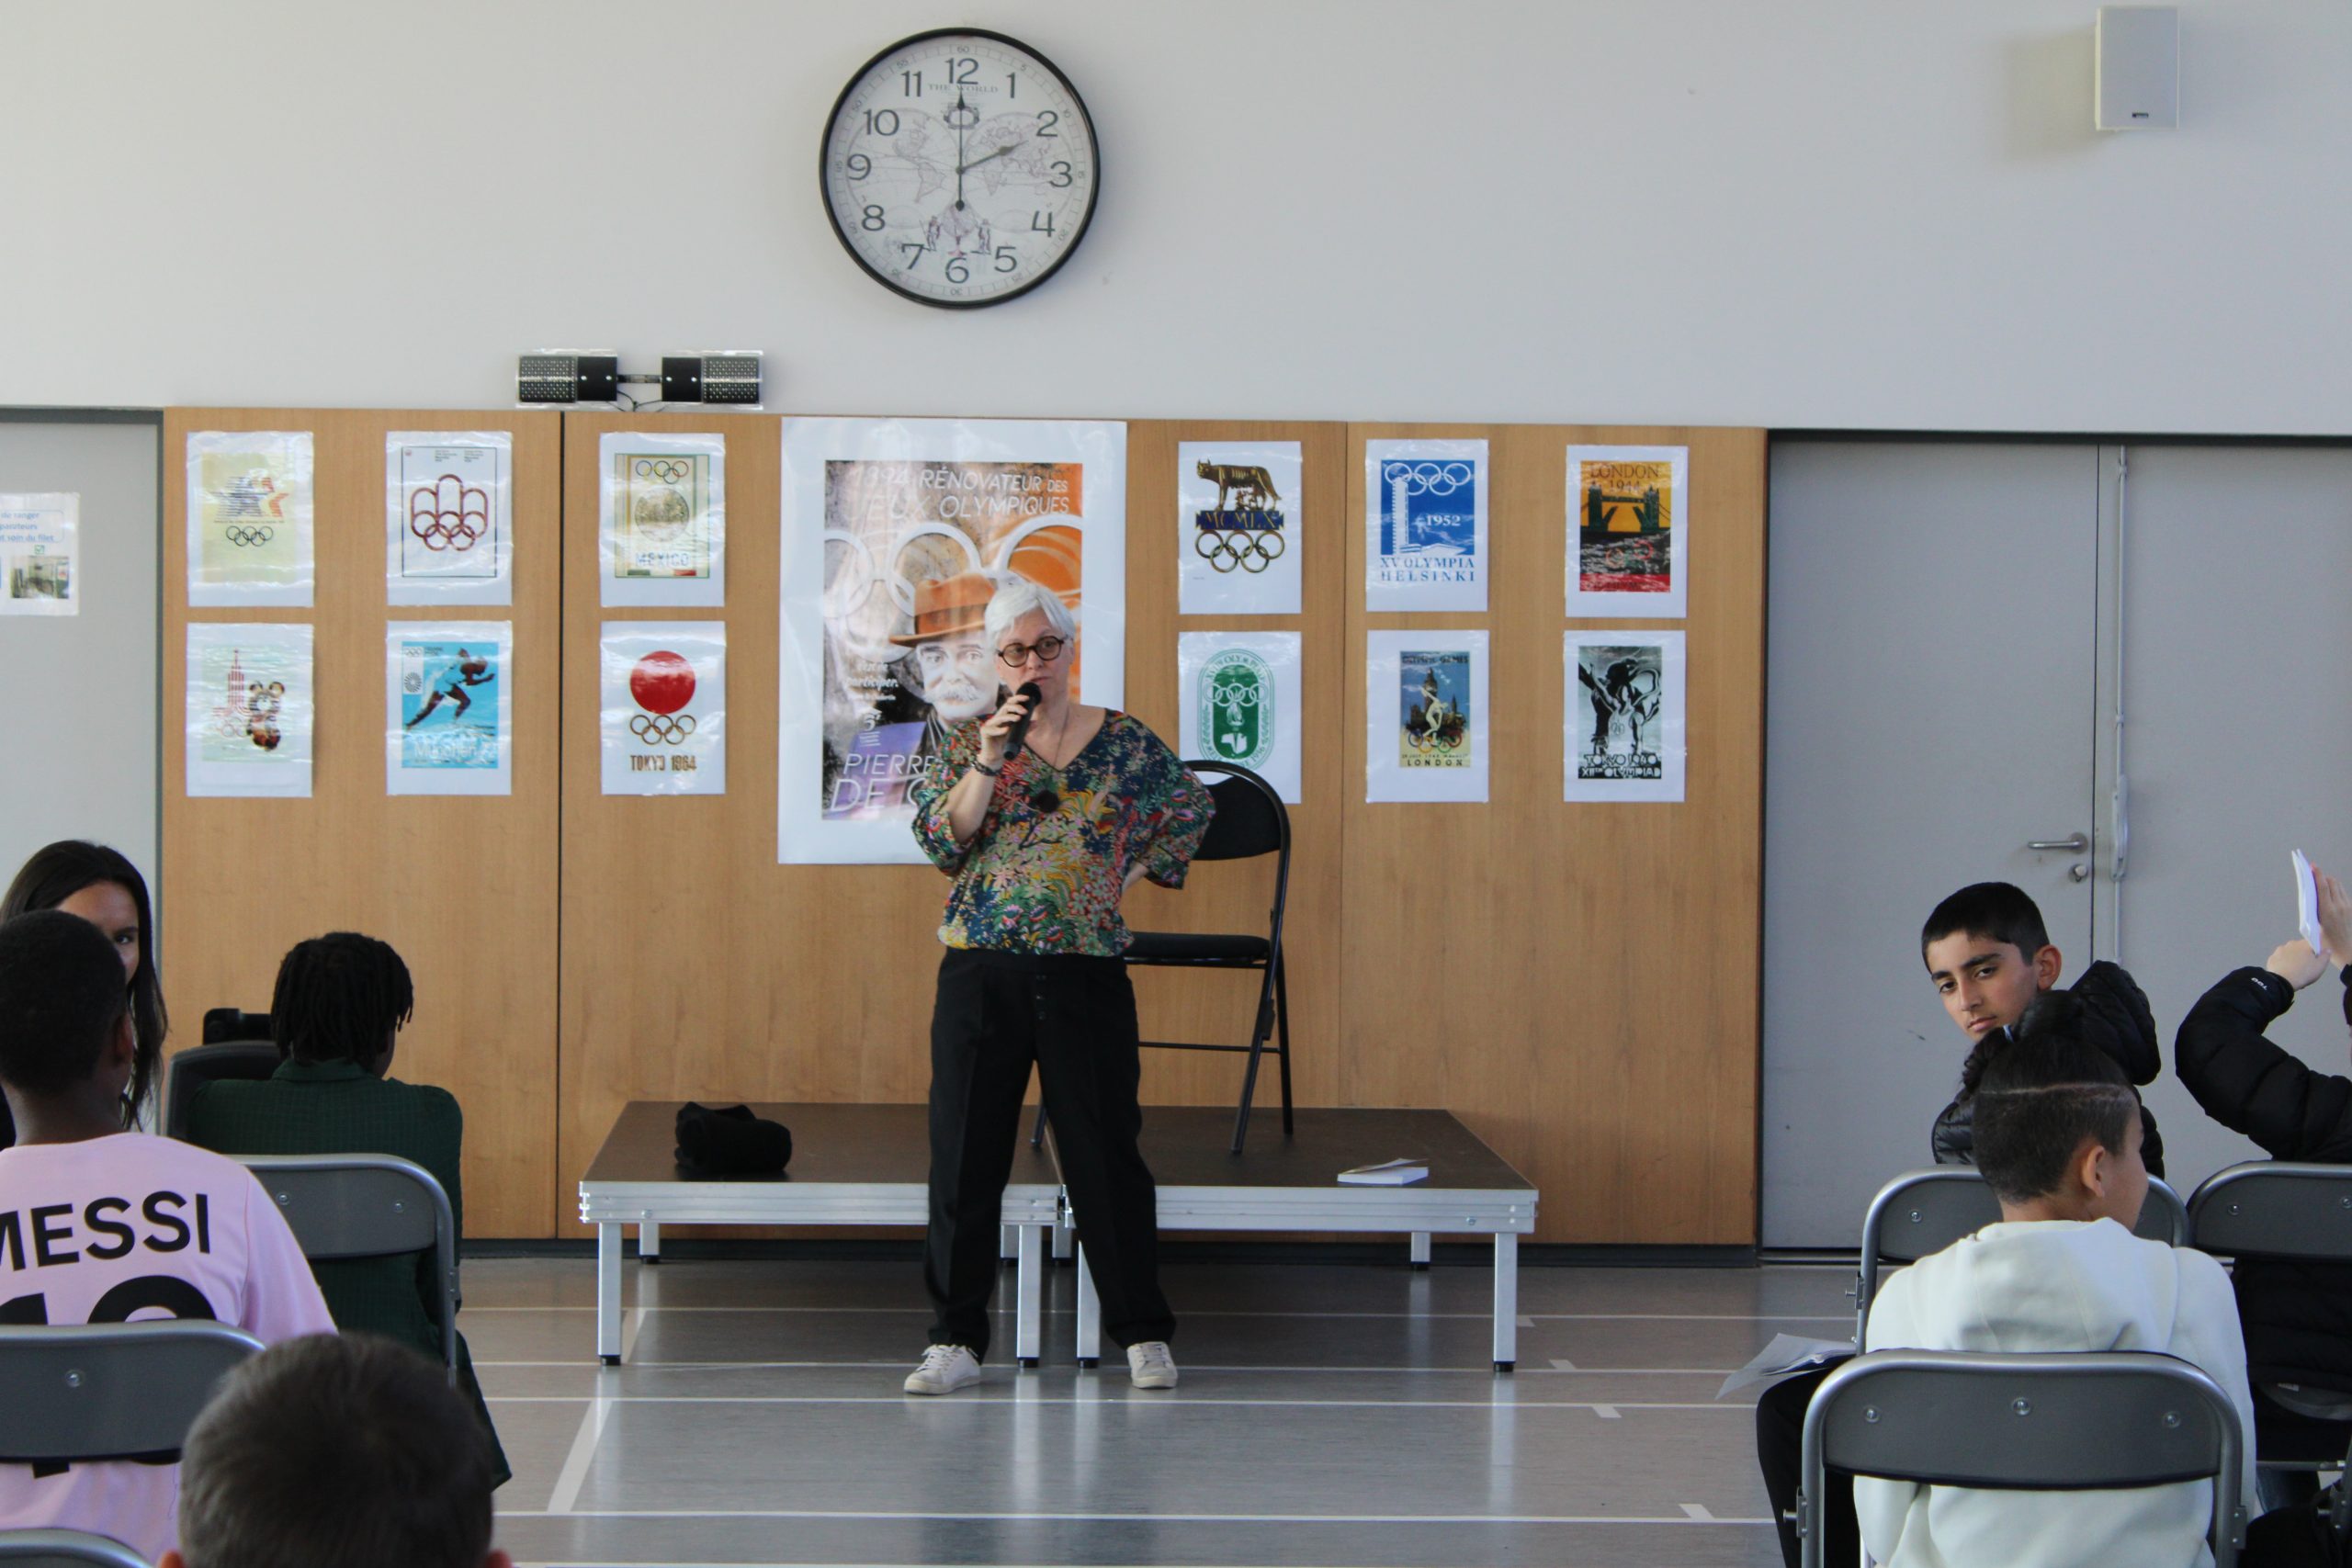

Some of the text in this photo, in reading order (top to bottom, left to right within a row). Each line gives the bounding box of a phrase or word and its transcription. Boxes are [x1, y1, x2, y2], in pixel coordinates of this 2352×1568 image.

[956, 45, 970, 53] 60
[901, 70, 922, 97] 11
[945, 58, 978, 85] 12
[956, 85, 999, 93] WORLD
[1006, 72, 1016, 98] 1
[864, 108, 899, 136] 10
[1036, 110, 1058, 137] 2
[847, 153, 872, 181] 9
[1048, 160, 1073, 187] 3
[862, 204, 886, 231] 8
[1030, 210, 1056, 238] 4
[901, 243, 924, 270] 7
[994, 245, 1017, 273] 5
[944, 256, 969, 284] 6
[919, 465, 1042, 491] RÉNOVATEUR
[1046, 479, 1069, 492] DES
[1590, 463, 1659, 479] LONDON
[939, 494, 1070, 518] OLYMPIQUES
[1426, 514, 1461, 526] 1952
[636, 552, 690, 567] MEXICO
[1380, 557, 1475, 568] XV OLYMPIA
[1381, 570, 1475, 581] HELSINKI
[630, 754, 697, 771] TOKYO 1964
[843, 753, 934, 775] PIERRE
[1408, 759, 1463, 767] LONDON
[1584, 754, 1626, 766] TOKYO
[1604, 766, 1661, 779] OLYMPIAD
[830, 777, 891, 812] DE
[0, 1190, 211, 1272] MESSI
